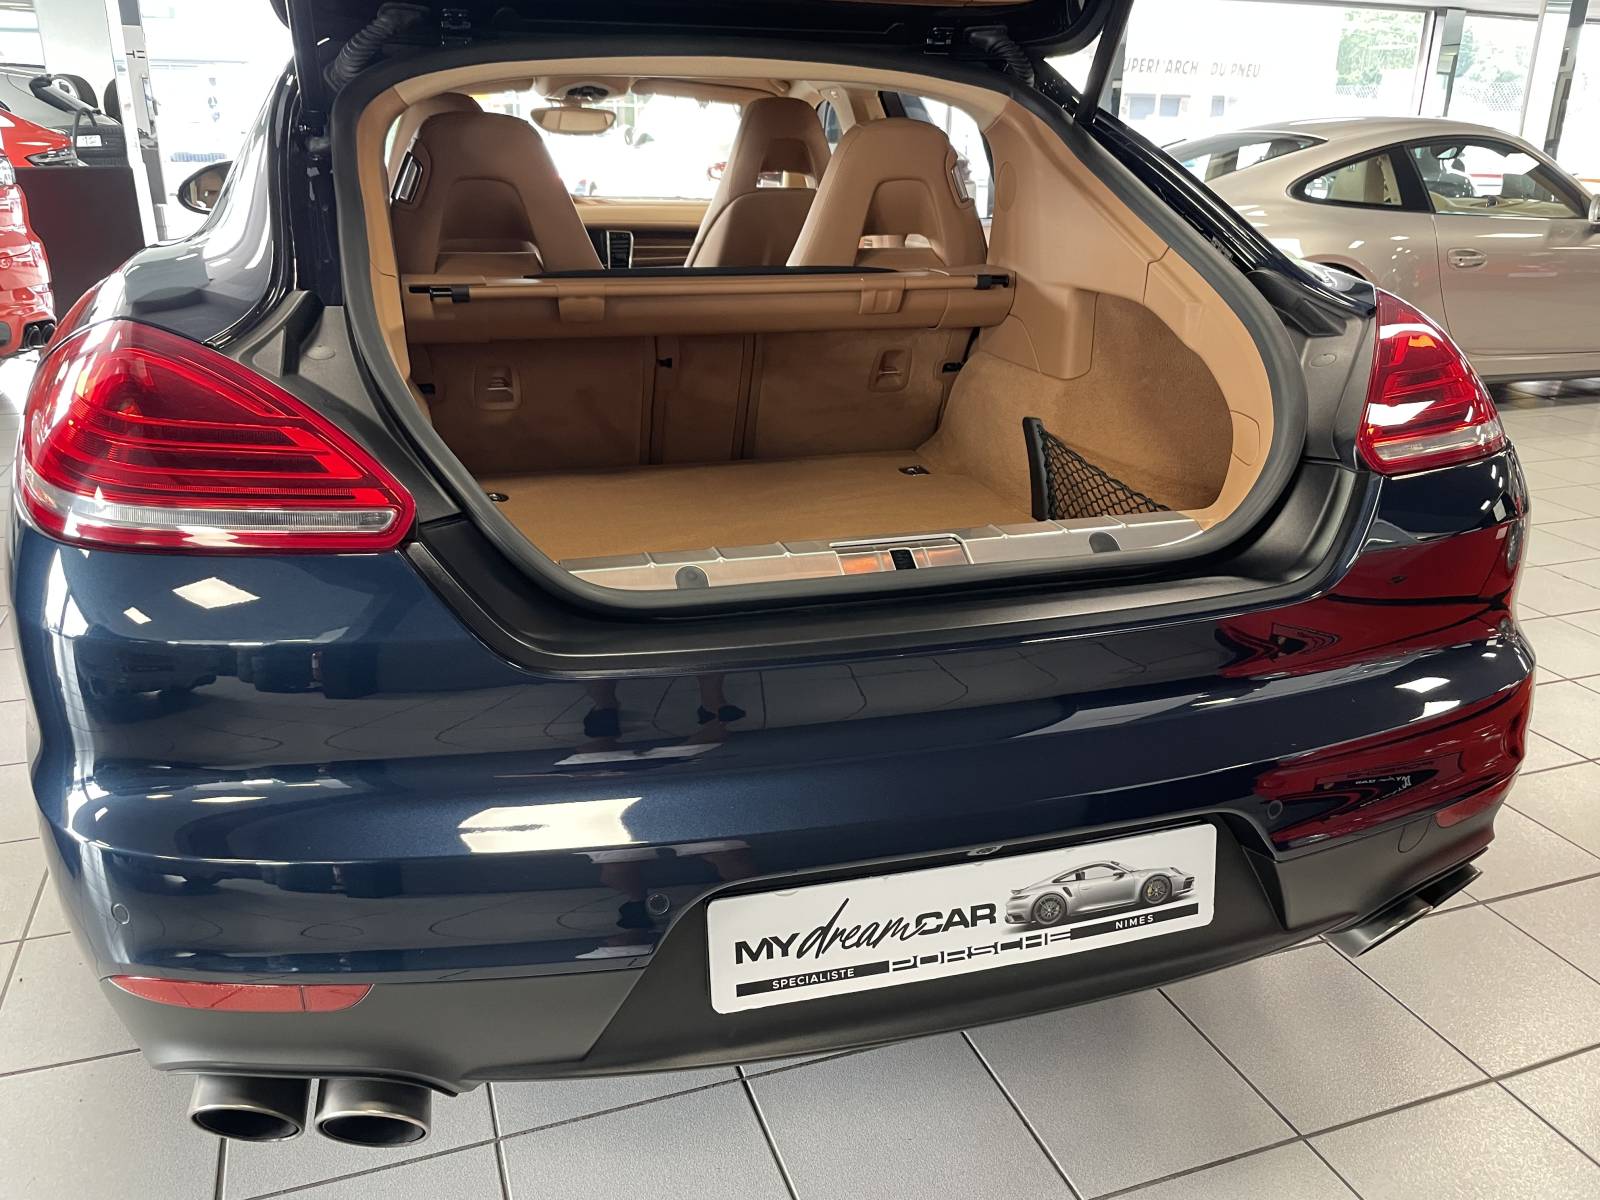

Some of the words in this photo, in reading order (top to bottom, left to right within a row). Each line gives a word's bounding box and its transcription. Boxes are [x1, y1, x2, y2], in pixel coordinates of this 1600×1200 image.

[1123, 57, 1201, 75] UPERARCH
[1231, 62, 1262, 79] PNEU
[734, 932, 801, 965] MY
[796, 897, 928, 960] dream
[915, 902, 997, 936] CAR
[772, 968, 855, 990] SPECIALISTE
[889, 931, 1071, 973] PORSCHE
[1115, 914, 1154, 930] NIMES
